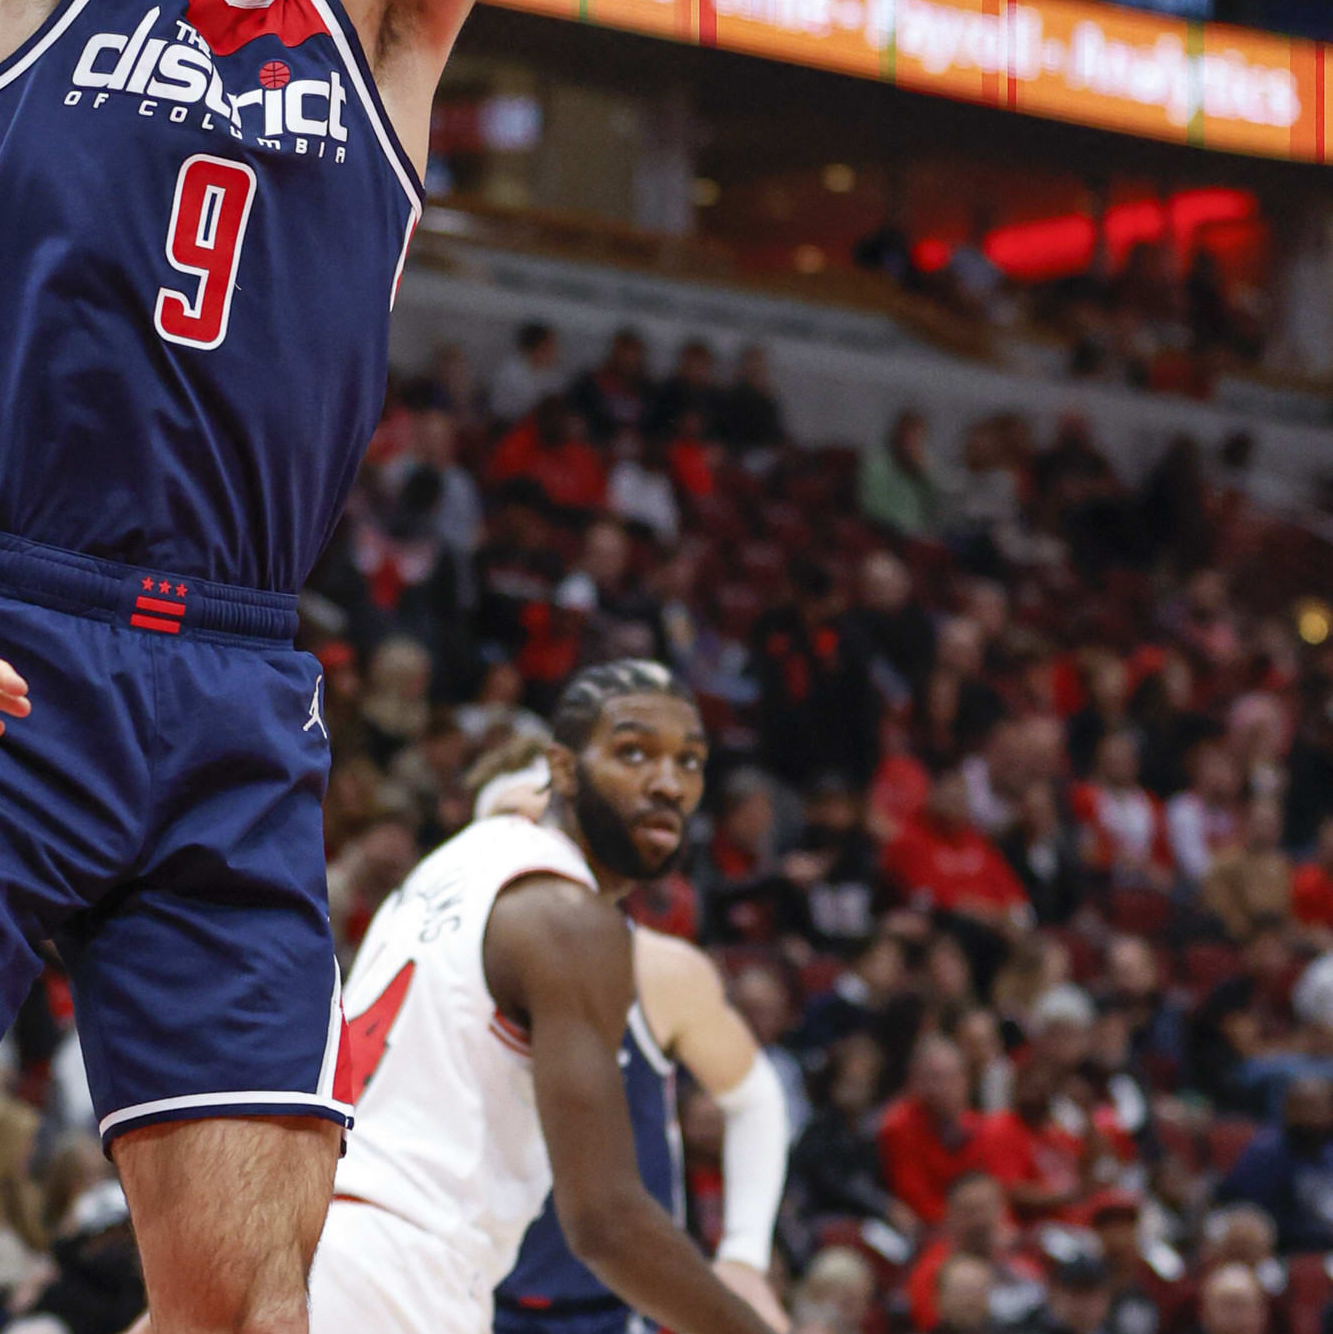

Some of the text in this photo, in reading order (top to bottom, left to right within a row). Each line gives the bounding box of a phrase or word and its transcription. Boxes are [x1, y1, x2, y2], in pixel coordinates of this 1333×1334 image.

[63, 90, 347, 164] OF COLUMBIA
[1068, 20, 1301, 128] Analytics
[153, 153, 258, 351] 9
